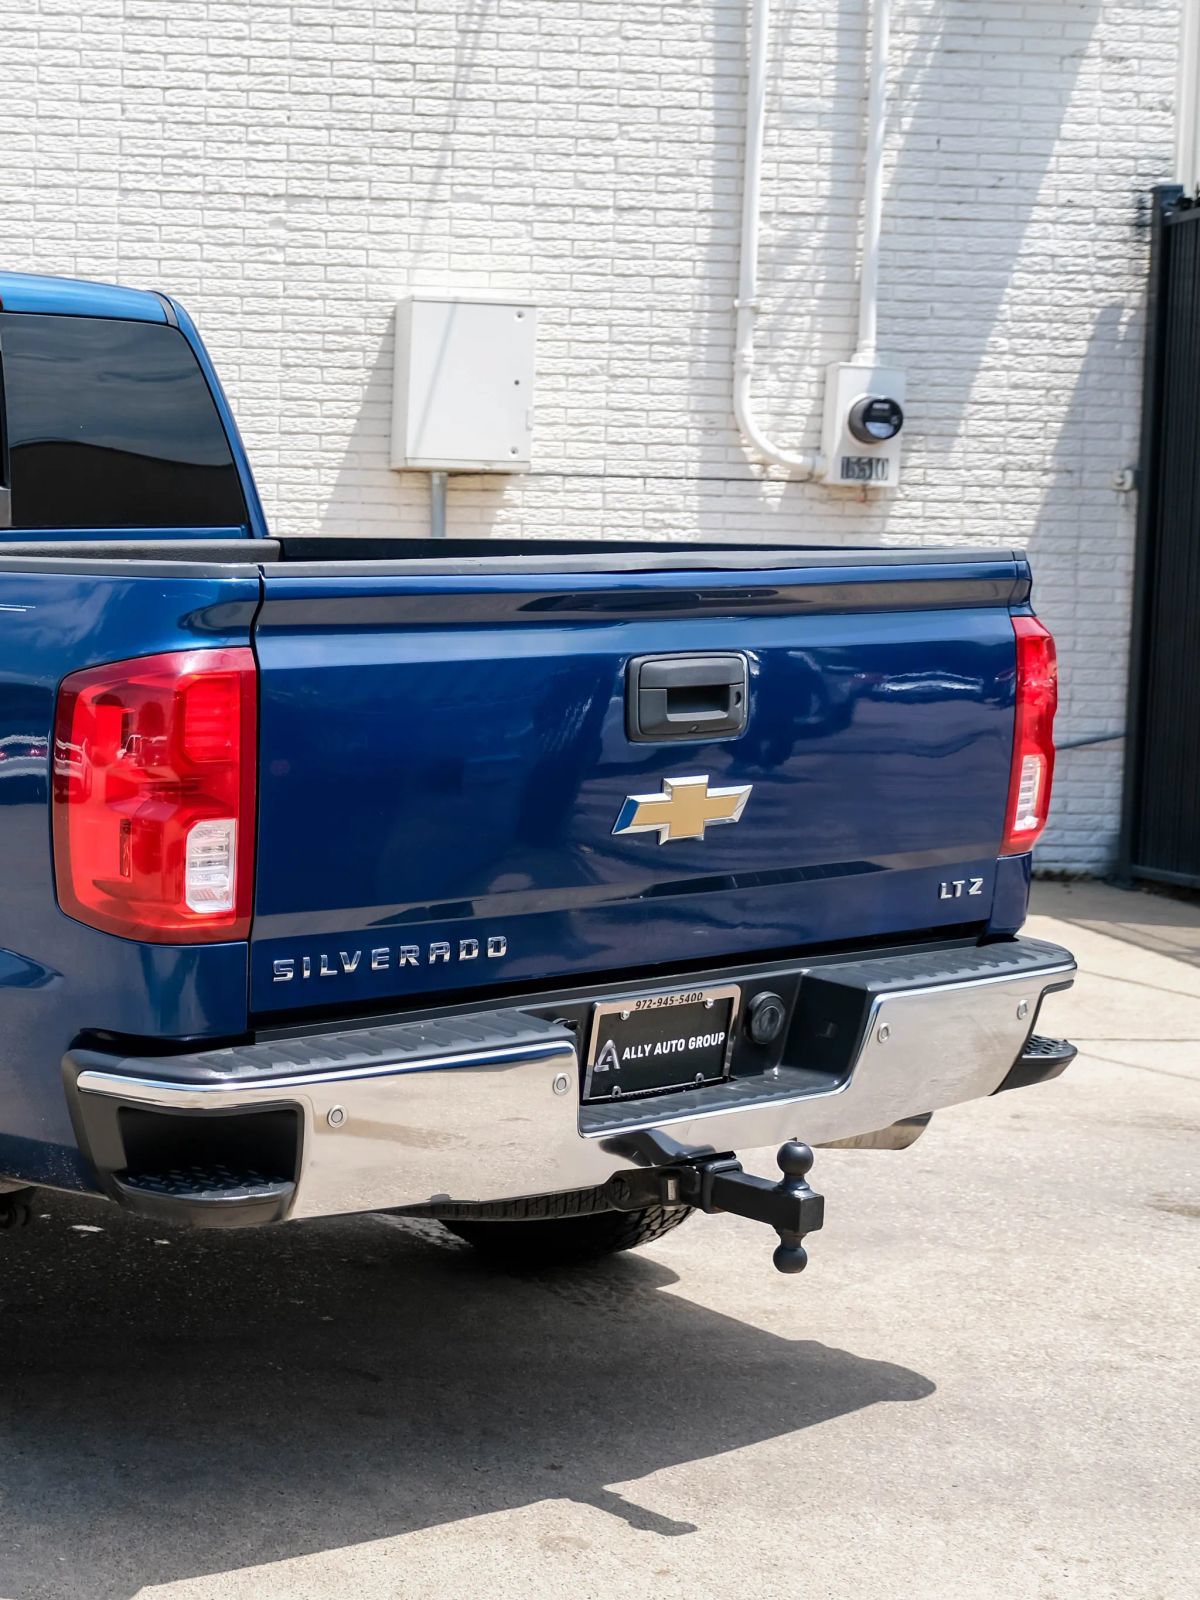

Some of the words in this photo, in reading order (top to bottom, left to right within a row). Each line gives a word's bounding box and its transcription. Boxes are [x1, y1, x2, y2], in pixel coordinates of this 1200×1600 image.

[940, 877, 984, 899] LTZ
[272, 935, 508, 982] SILVERADO
[635, 991, 703, 1010] 972-945-5400
[622, 1043, 652, 1060] ALLY
[653, 1038, 685, 1056] AUTO
[688, 1031, 726, 1050] GROUP
